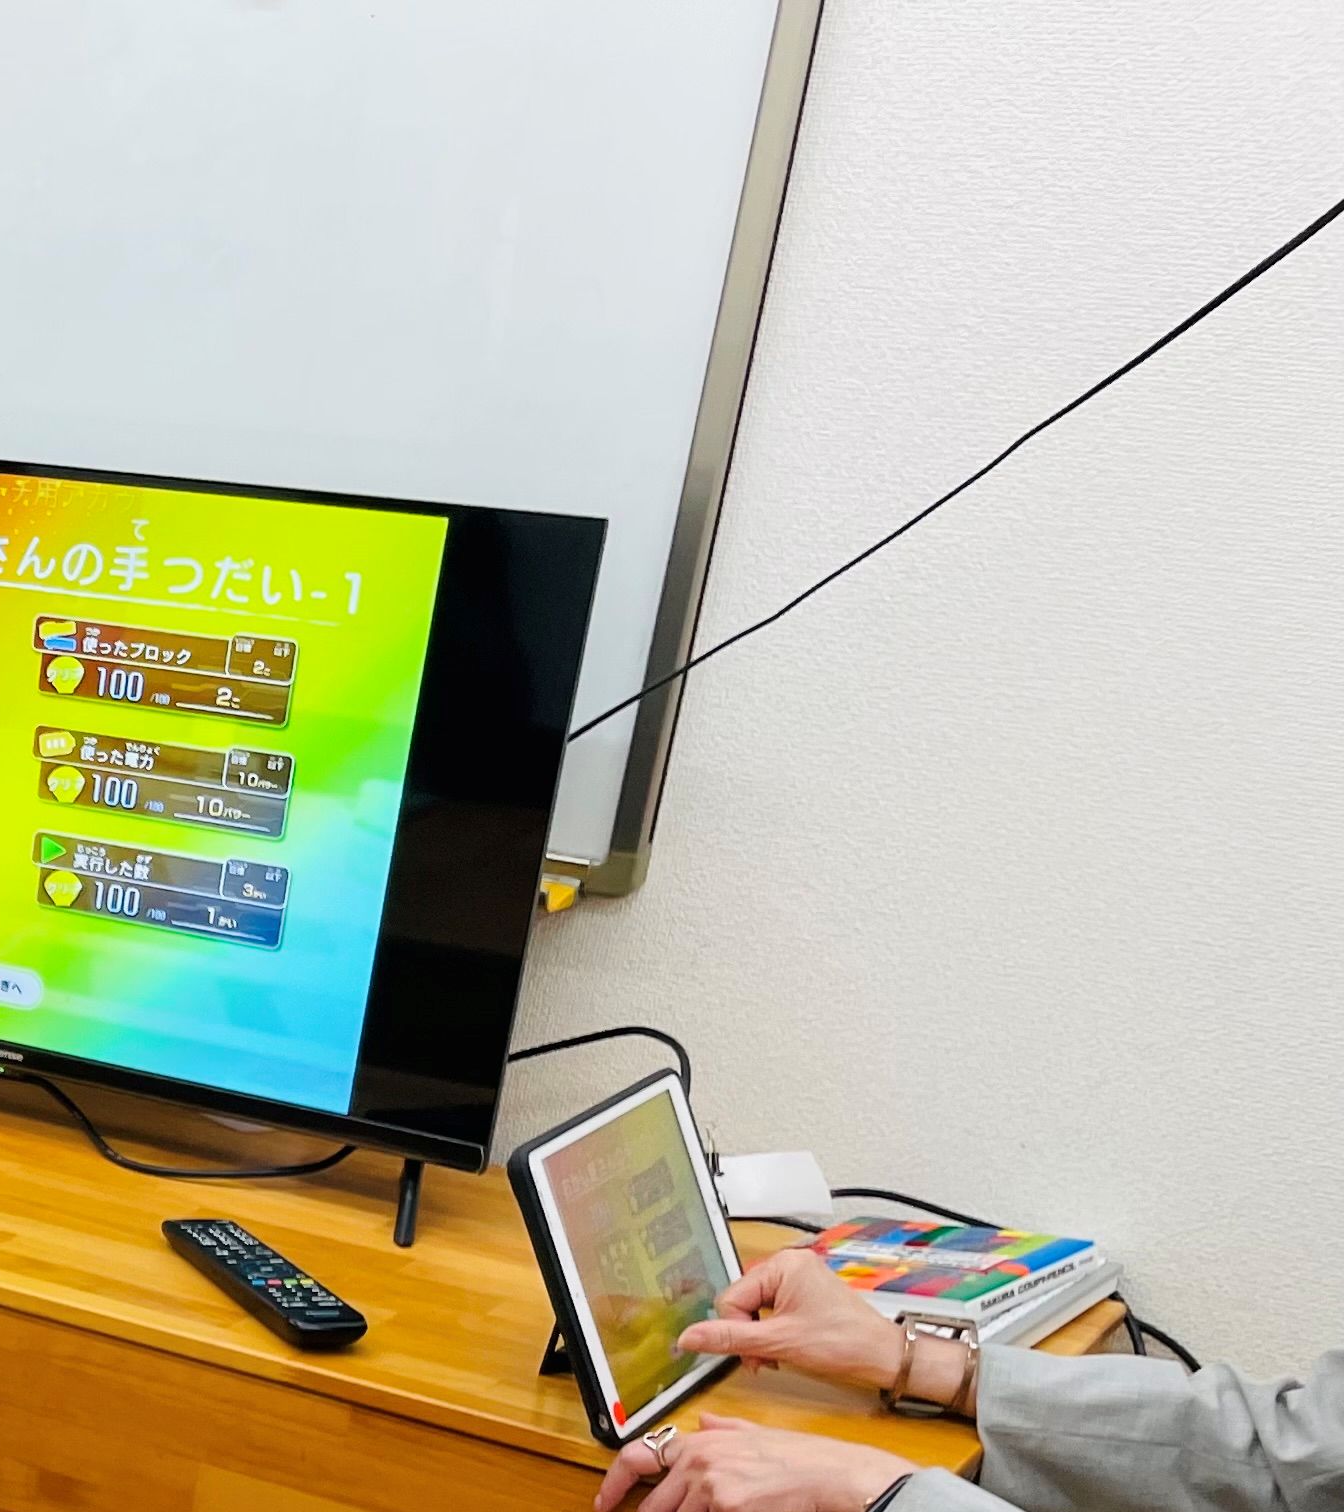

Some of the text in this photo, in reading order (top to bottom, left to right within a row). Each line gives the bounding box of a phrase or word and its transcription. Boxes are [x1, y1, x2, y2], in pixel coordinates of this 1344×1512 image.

[131, 518, 151, 541] て
[97, 666, 145, 702] 100
[91, 773, 138, 809] 100
[95, 880, 141, 917] 100
